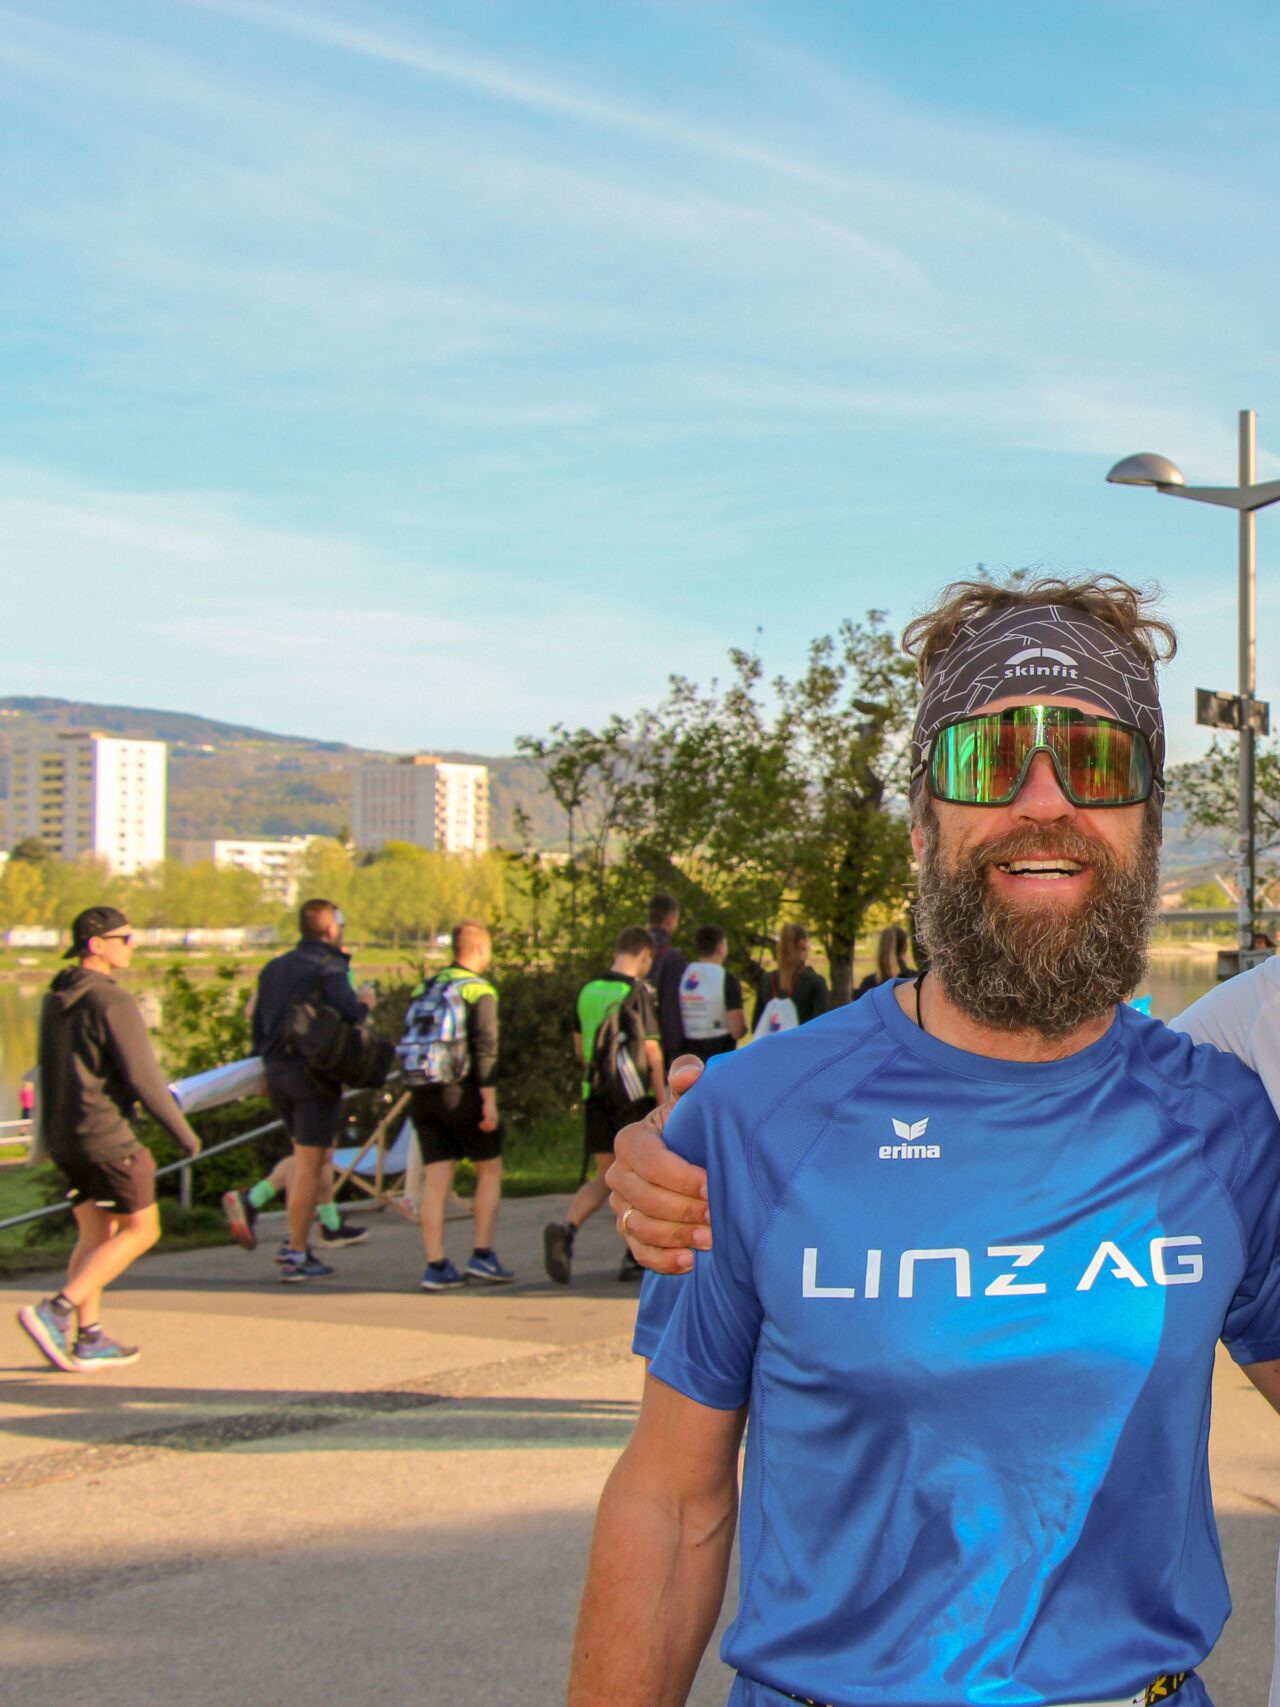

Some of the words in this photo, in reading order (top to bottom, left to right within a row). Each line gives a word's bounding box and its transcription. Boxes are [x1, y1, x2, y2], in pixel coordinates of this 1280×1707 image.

[1004, 664, 1079, 680] skinfit
[878, 1142, 941, 1160] erima
[802, 1244, 1047, 1299] LINZ
[1075, 1235, 1204, 1292] AG
